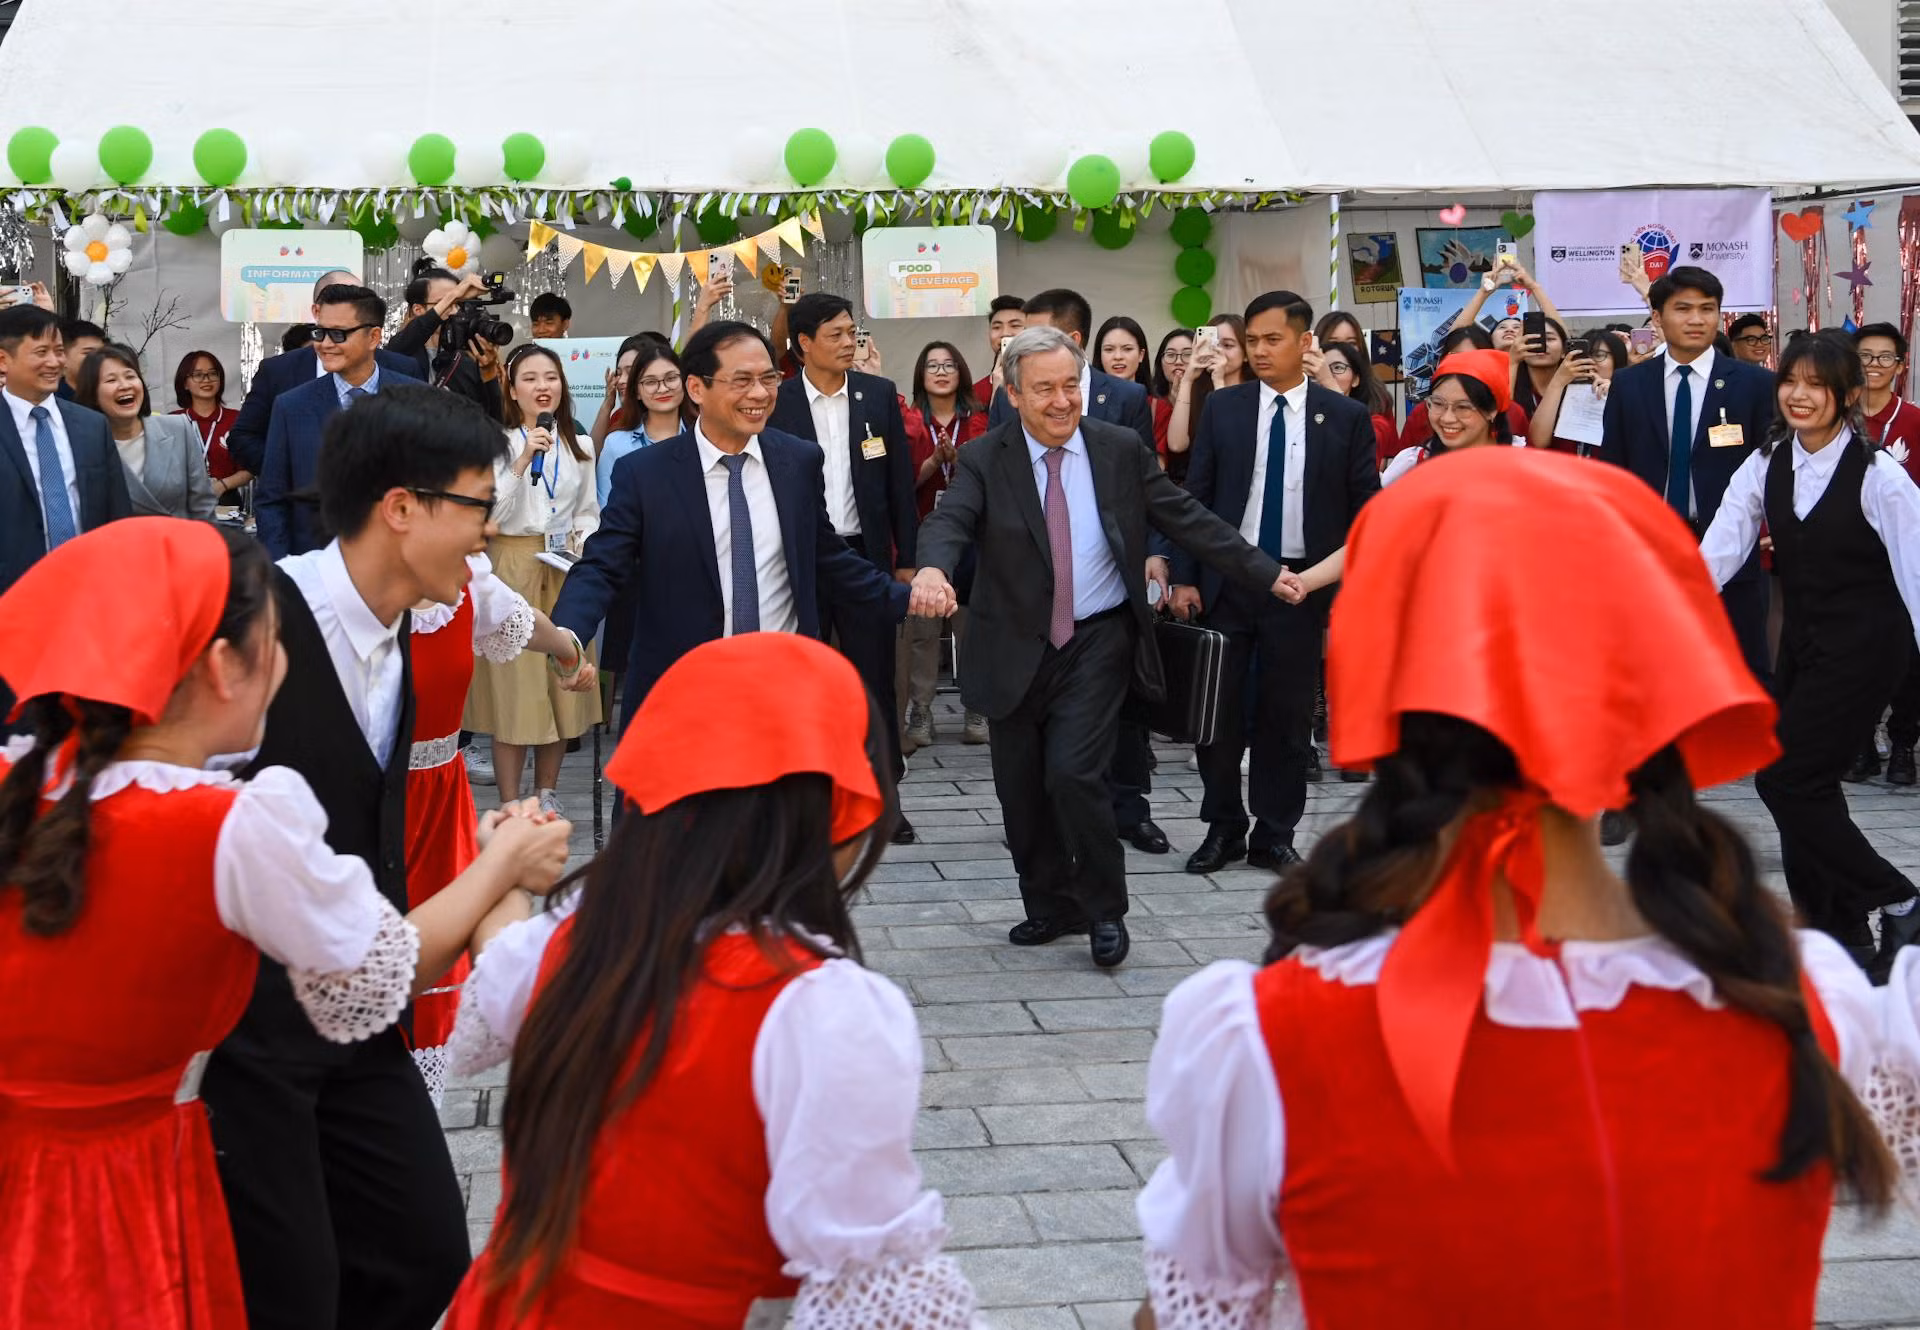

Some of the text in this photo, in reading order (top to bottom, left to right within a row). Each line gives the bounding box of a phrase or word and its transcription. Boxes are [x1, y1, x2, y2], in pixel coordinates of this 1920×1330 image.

[1706, 240, 1748, 251] MONASH
[1705, 251, 1745, 261] University
[899, 264, 932, 273] FOOD
[248, 269, 325, 278] INFORMATI
[911, 276, 973, 285] BEVERAGE
[1414, 296, 1443, 305] MONASH
